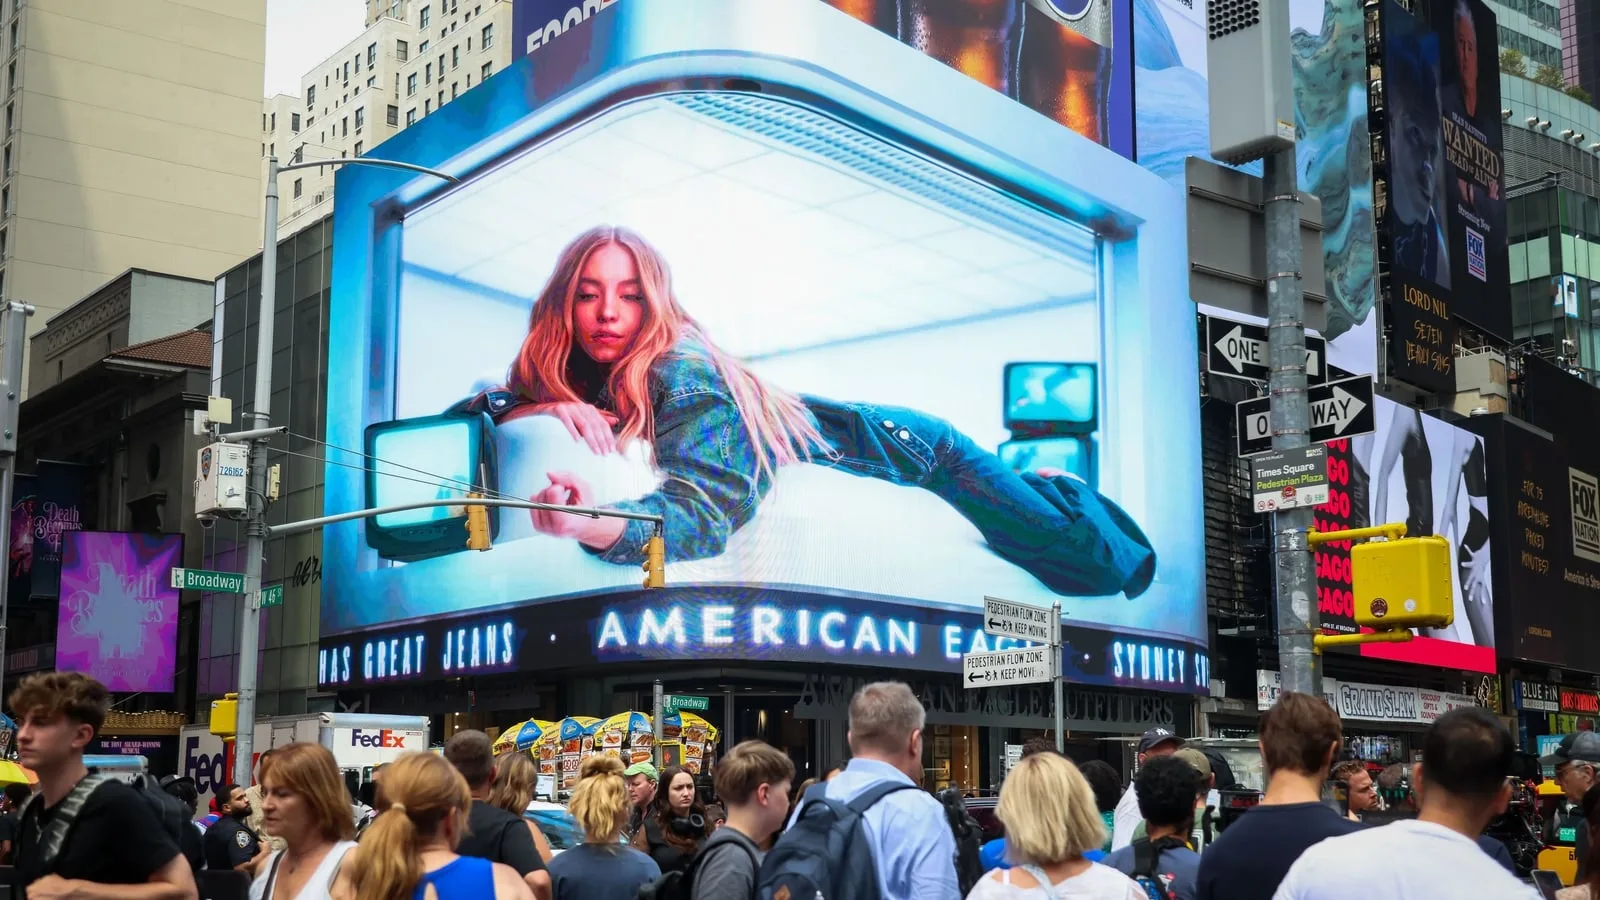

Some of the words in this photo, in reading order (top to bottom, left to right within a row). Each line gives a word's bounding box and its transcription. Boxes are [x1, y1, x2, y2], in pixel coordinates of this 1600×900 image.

[1442, 116, 1500, 178] WANTED
[1446, 145, 1468, 172] DEAD
[1468, 233, 1484, 258] FOX
[1404, 283, 1431, 311] LORD
[1432, 297, 1449, 320] NIL
[1227, 337, 1261, 363] ONE
[1311, 397, 1352, 426] WAY
[1256, 468, 1283, 478] Times
[1283, 463, 1316, 476] Square
[1256, 477, 1301, 491] Pedestrian
[1301, 473, 1325, 484] Plaza
[43, 501, 80, 522] Death
[1572, 481, 1597, 521] FOX
[34, 516, 83, 540] Becomes
[1574, 521, 1600, 545] NATION
[188, 572, 241, 593] Broadway
[261, 590, 269, 606] W
[987, 601, 1019, 618] PEDESTRIAN
[1019, 608, 1033, 620] FLOW
[1034, 610, 1047, 624] ZONE
[1014, 622, 1027, 635] KEEP
[1028, 624, 1048, 639] MOVING
[319, 646, 351, 684] HAS
[364, 635, 424, 680] GREAT
[443, 622, 513, 671] JEANS
[597, 604, 916, 656] AMERICAN
[1113, 641, 1185, 685] SYDNEY
[967, 654, 1006, 669] PEDESTRIAN
[1007, 652, 1025, 665] FLOW
[1025, 651, 1044, 664] ZONE
[1000, 668, 1018, 680] KEEP
[1522, 681, 1542, 700] BLUE
[1544, 685, 1558, 701] FIN
[672, 697, 707, 710] Broadway
[351, 729, 405, 748] FedEx
